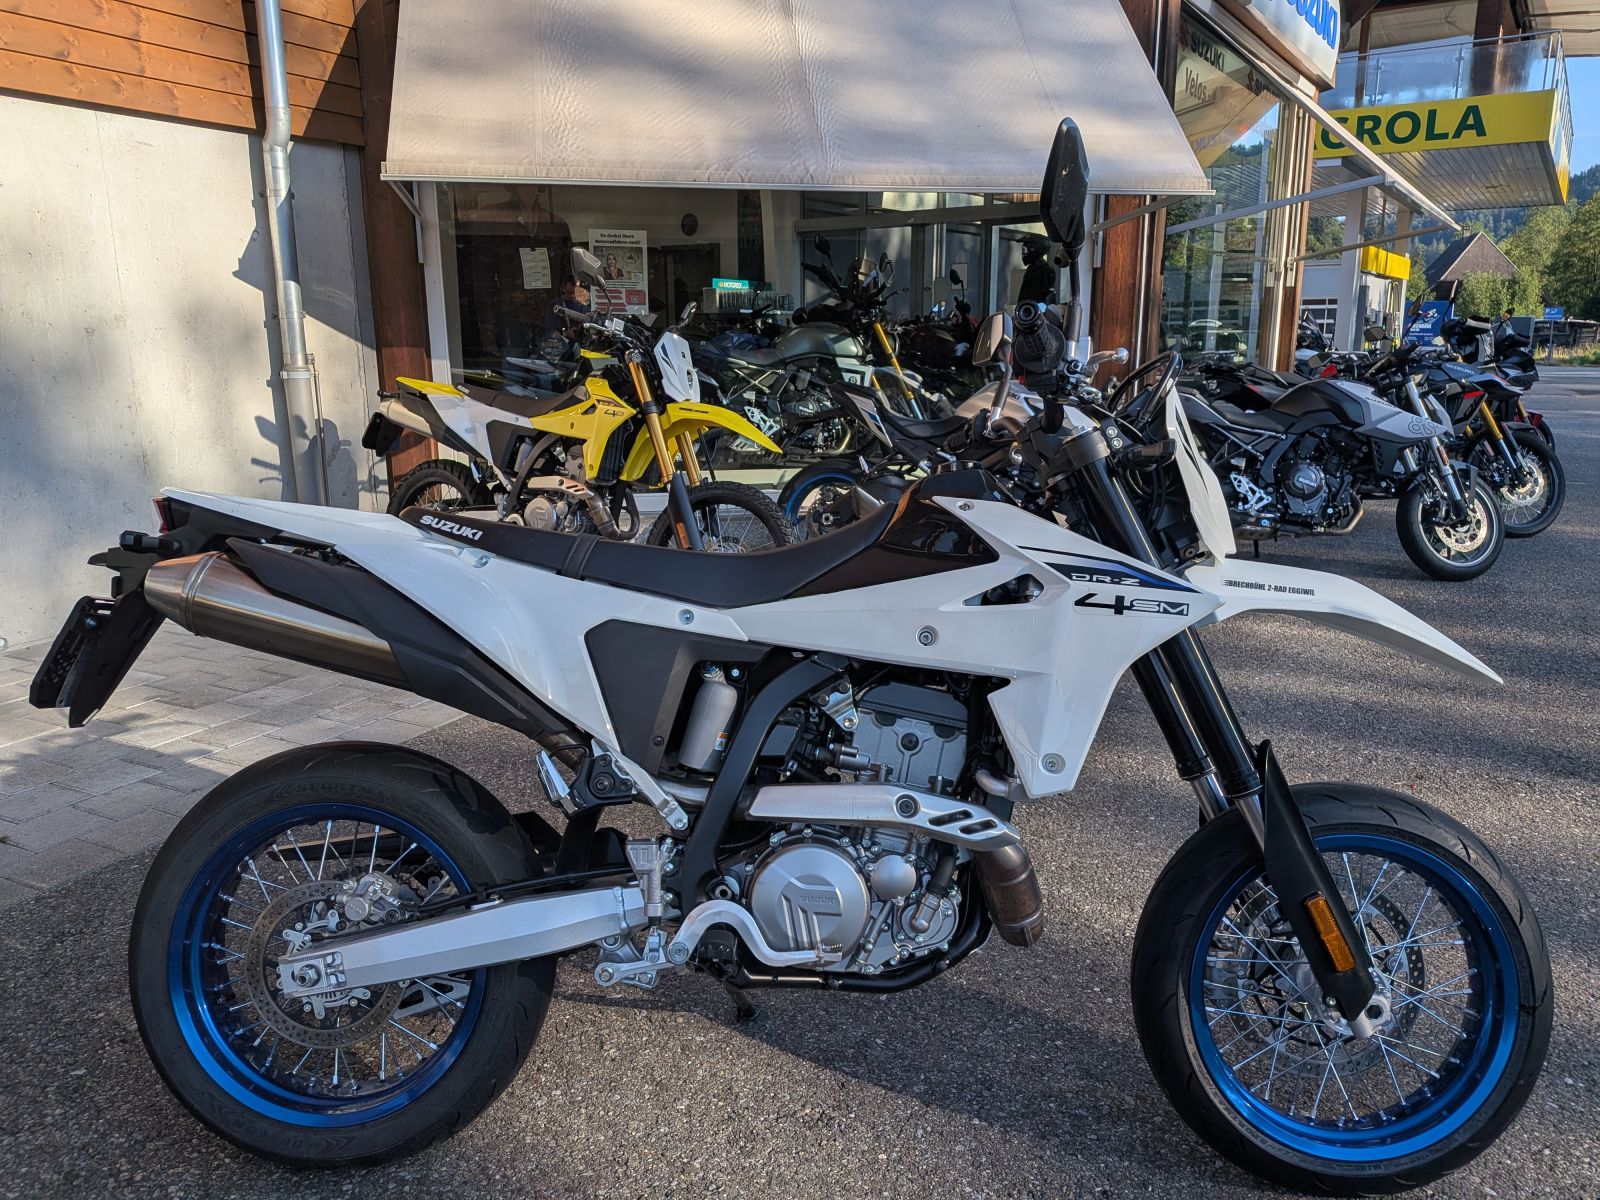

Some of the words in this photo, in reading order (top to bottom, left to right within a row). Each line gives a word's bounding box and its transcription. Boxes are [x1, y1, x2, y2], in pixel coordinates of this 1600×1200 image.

[1287, 0, 1338, 50] ZUKI
[1190, 31, 1225, 72] SUZUKI
[1185, 66, 1208, 102] Velos
[1314, 104, 1488, 151] GROLA
[723, 281, 743, 289] MOTOREX
[419, 514, 484, 541] SUZUKI
[1070, 572, 1141, 586] DR-Z
[1226, 579, 1266, 591] BRECHBÜHL
[1267, 584, 1288, 593] 2-RAD
[1288, 586, 1316, 597] EGGIWIL
[799, 894, 840, 905] SUZUKI
